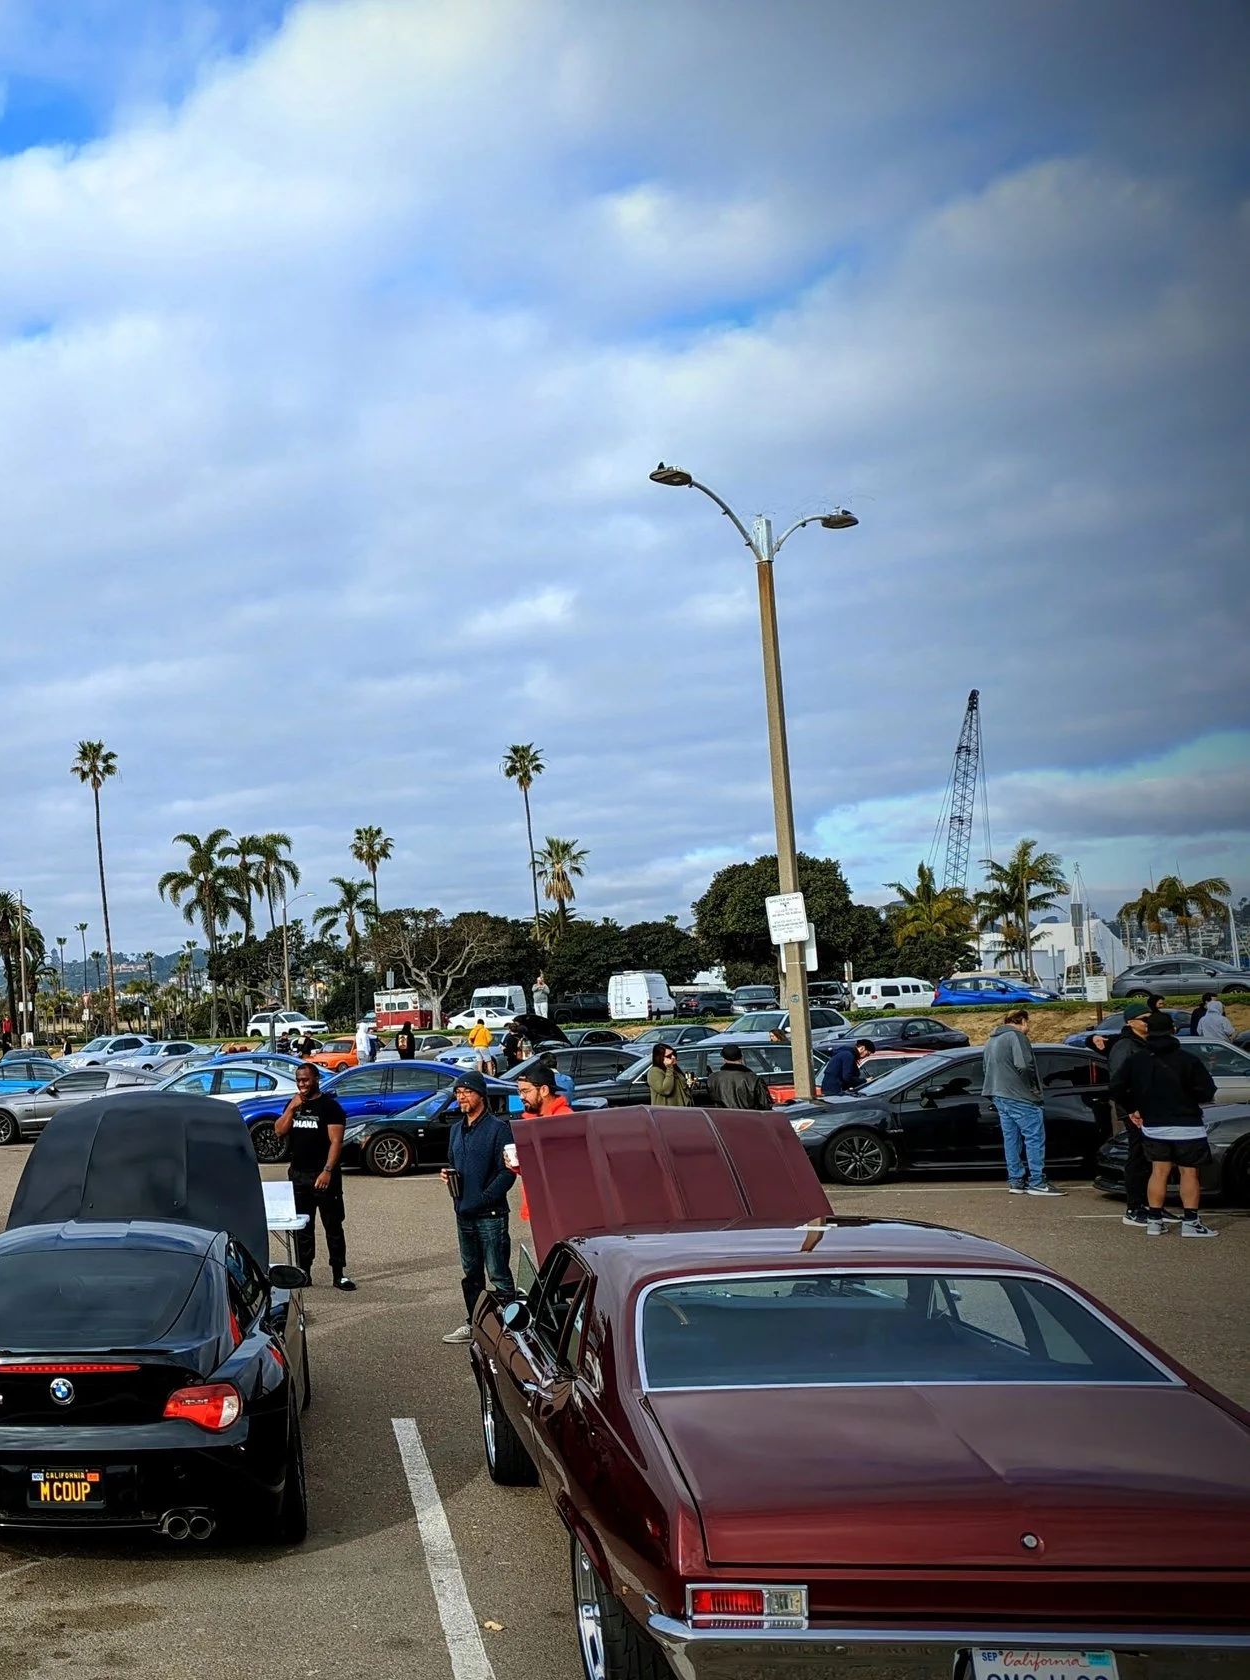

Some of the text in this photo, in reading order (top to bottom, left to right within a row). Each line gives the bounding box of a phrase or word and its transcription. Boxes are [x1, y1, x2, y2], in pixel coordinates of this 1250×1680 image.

[40, 1481, 91, 1501] M COUP
[982, 1652, 998, 1662] SEP
[1003, 1650, 1091, 1671] California
